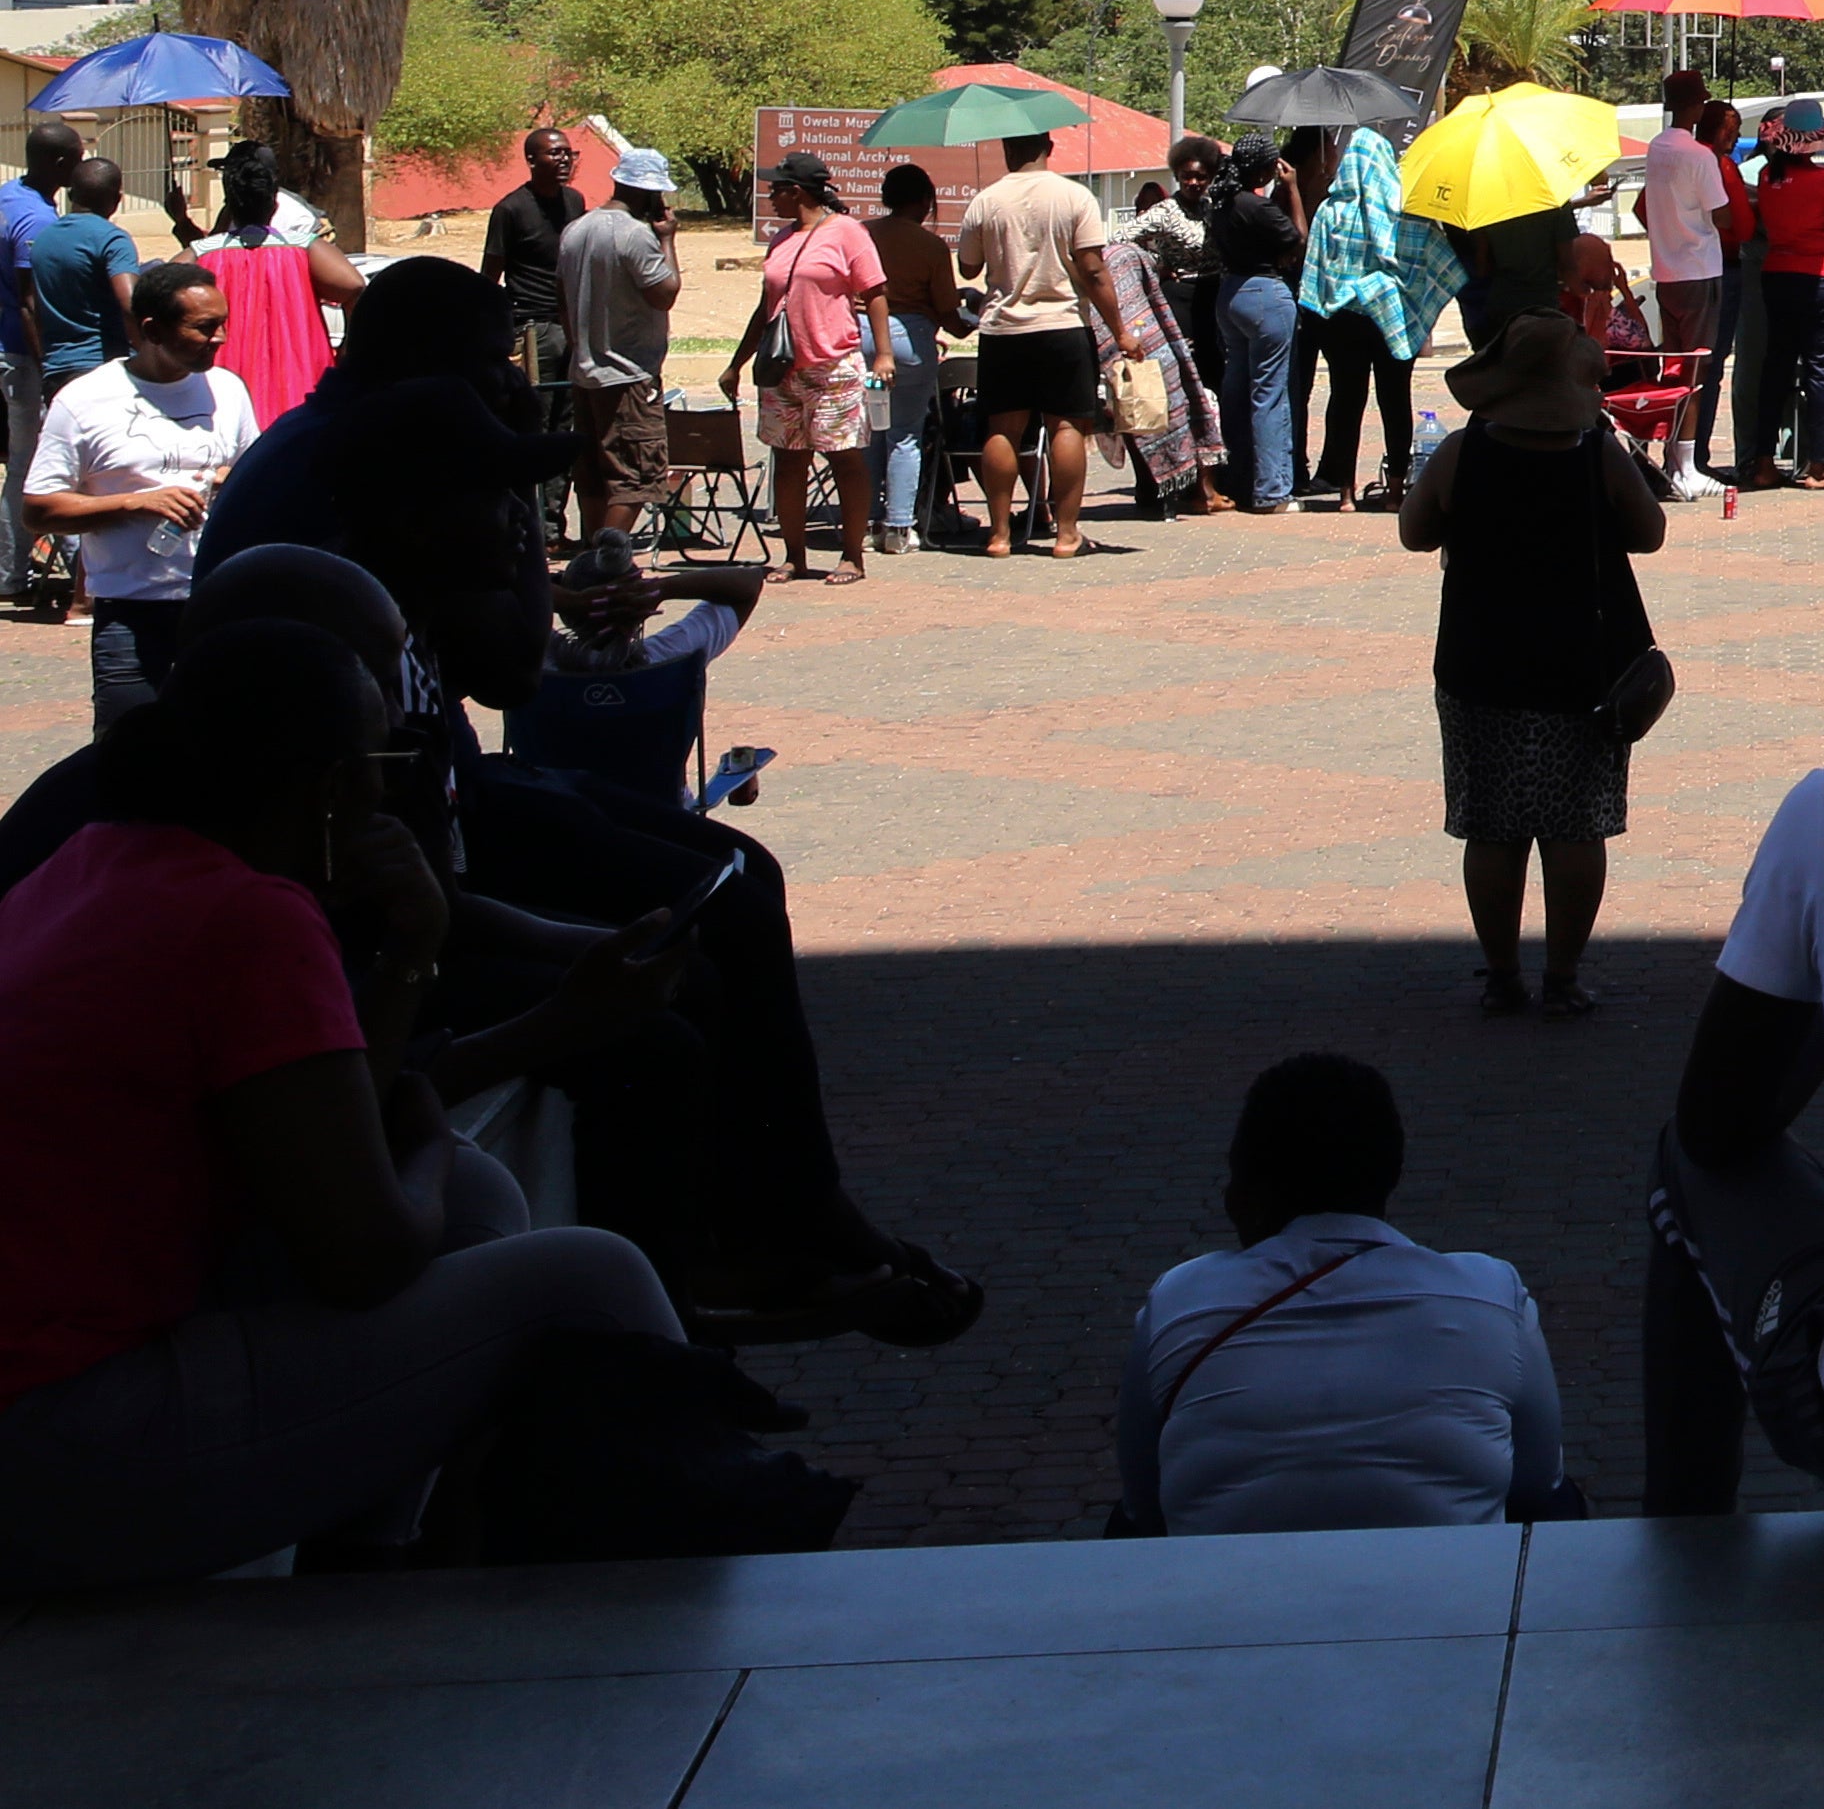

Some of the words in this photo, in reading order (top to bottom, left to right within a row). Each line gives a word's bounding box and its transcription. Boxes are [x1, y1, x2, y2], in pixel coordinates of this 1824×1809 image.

[802, 115, 840, 128] Owela
[801, 132, 853, 145] National
[828, 165, 886, 179] Windhoek
[1436, 185, 1452, 201] TC
